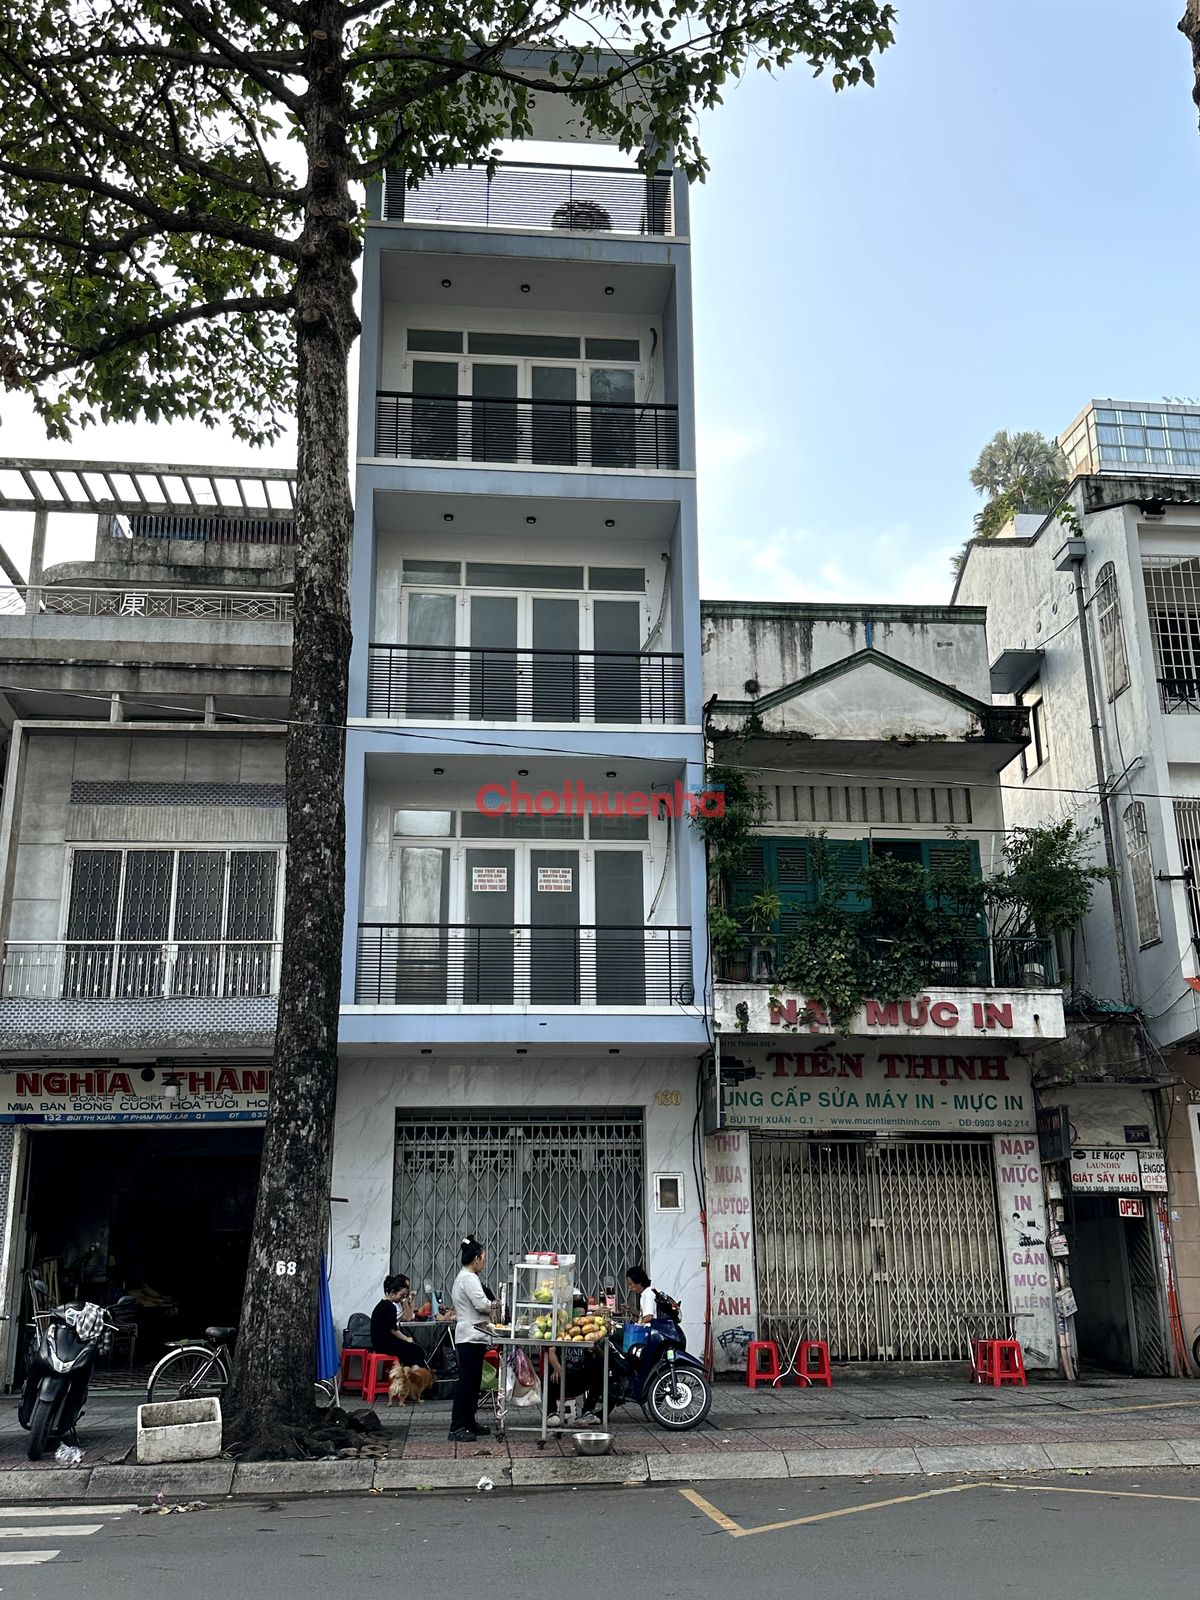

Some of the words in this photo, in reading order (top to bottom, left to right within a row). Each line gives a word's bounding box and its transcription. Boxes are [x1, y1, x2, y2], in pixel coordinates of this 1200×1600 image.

[770, 999, 841, 1033] NẠ
[973, 1003, 1013, 1028] IN
[766, 1041, 865, 1078] TIẾN
[878, 1054, 1009, 1086] THỊNH
[162, 1068, 272, 1096] THÀN
[8, 1103, 34, 1111] MUA
[170, 1101, 201, 1110] HOA
[656, 1091, 681, 1105] 130
[723, 1091, 763, 1107] UNG
[770, 1086, 811, 1107] CẤP
[819, 1086, 859, 1108] SỬA
[866, 1089, 908, 1108] MÁY
[916, 1094, 934, 1109] IN
[954, 1093, 997, 1112] MỰC
[1004, 1096, 1023, 1110] IN
[799, 1116, 813, 1124] Q.1
[830, 1117, 940, 1126] www.mucintienthinh.com
[997, 1119, 1012, 1127] 842
[1015, 1120, 1030, 1128] 214
[714, 1135, 740, 1152] THU
[1000, 1139, 1035, 1159] NẠP
[715, 1166, 742, 1183] MUA
[1001, 1164, 1039, 1187] MỰC
[1097, 1170, 1114, 1183] SẤY
[1119, 1171, 1138, 1183] KHÔ
[712, 1197, 749, 1215] LAPTOP
[1014, 1195, 1032, 1211] IN
[1120, 1200, 1142, 1215] OPEN
[712, 1224, 750, 1249] GIẤY
[1012, 1248, 1045, 1265] GẮN
[276, 1260, 297, 1276] 68
[725, 1264, 741, 1282] IN
[1014, 1272, 1047, 1290] MỰC
[718, 1290, 751, 1315] ẢNH
[1015, 1293, 1050, 1309] LIÊN
